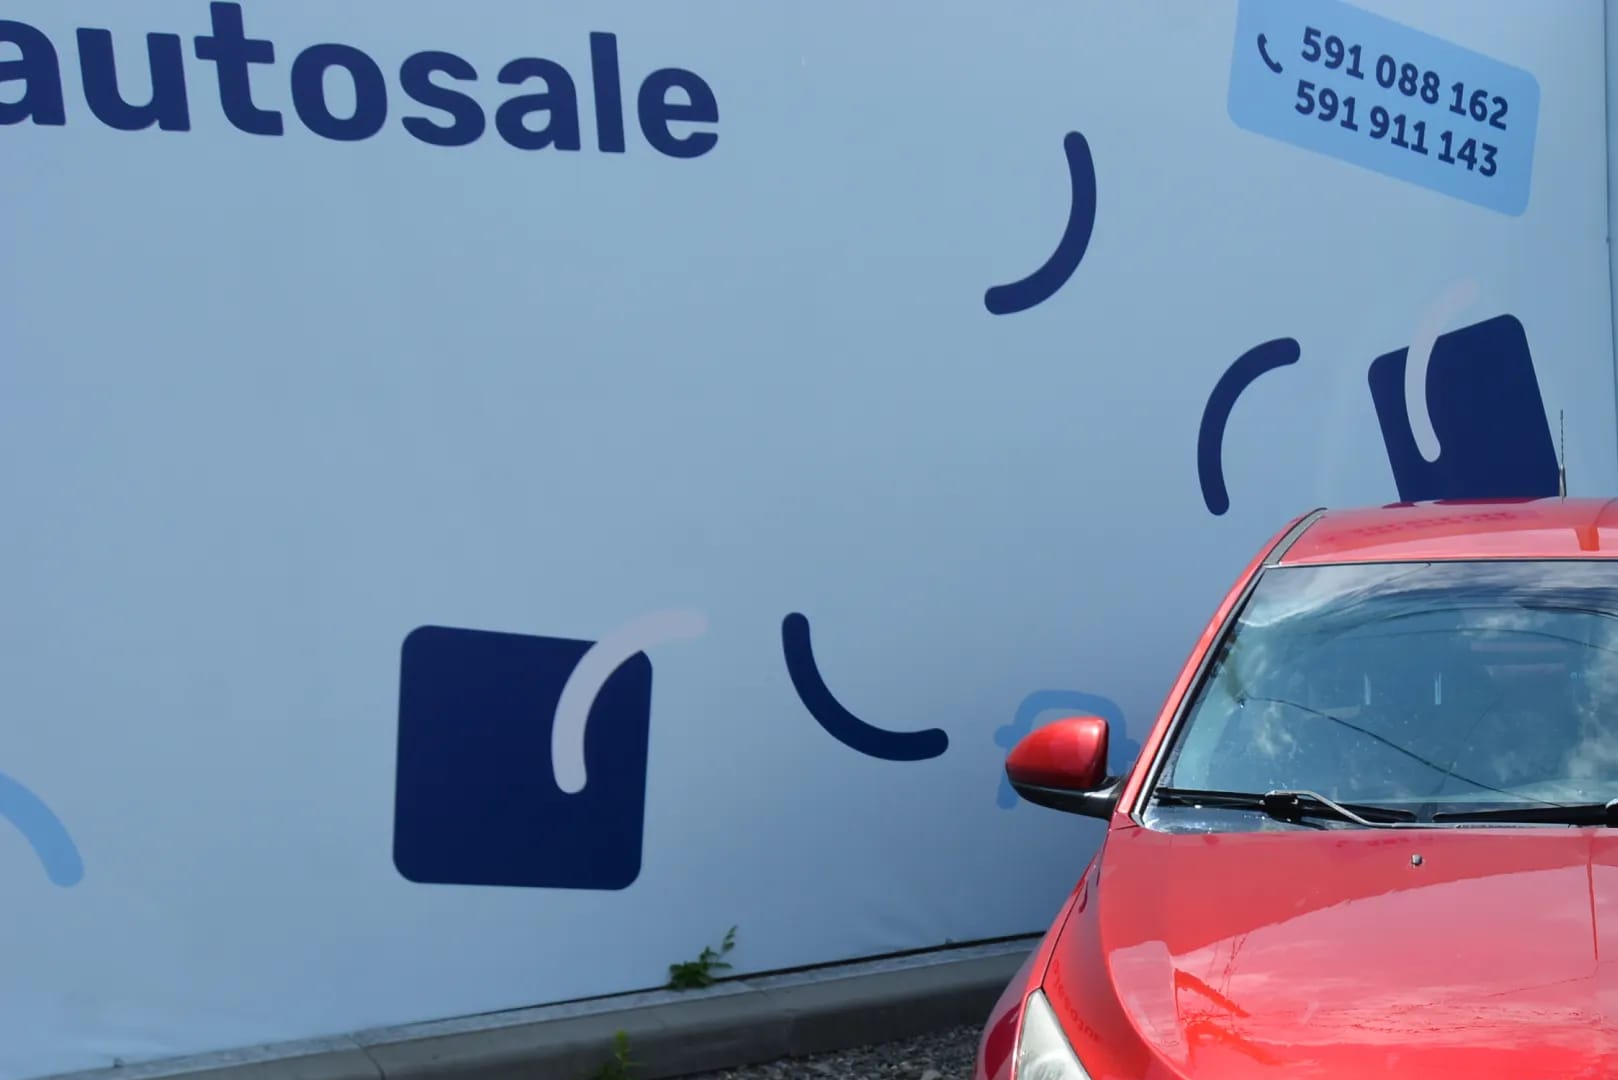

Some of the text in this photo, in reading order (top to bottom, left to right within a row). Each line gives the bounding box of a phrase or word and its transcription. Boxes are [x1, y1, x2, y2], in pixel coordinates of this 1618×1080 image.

[0, 1, 719, 159] autosale
[1295, 79, 1498, 177] 591 911 143
[1301, 26, 1509, 131] 591 088 162
